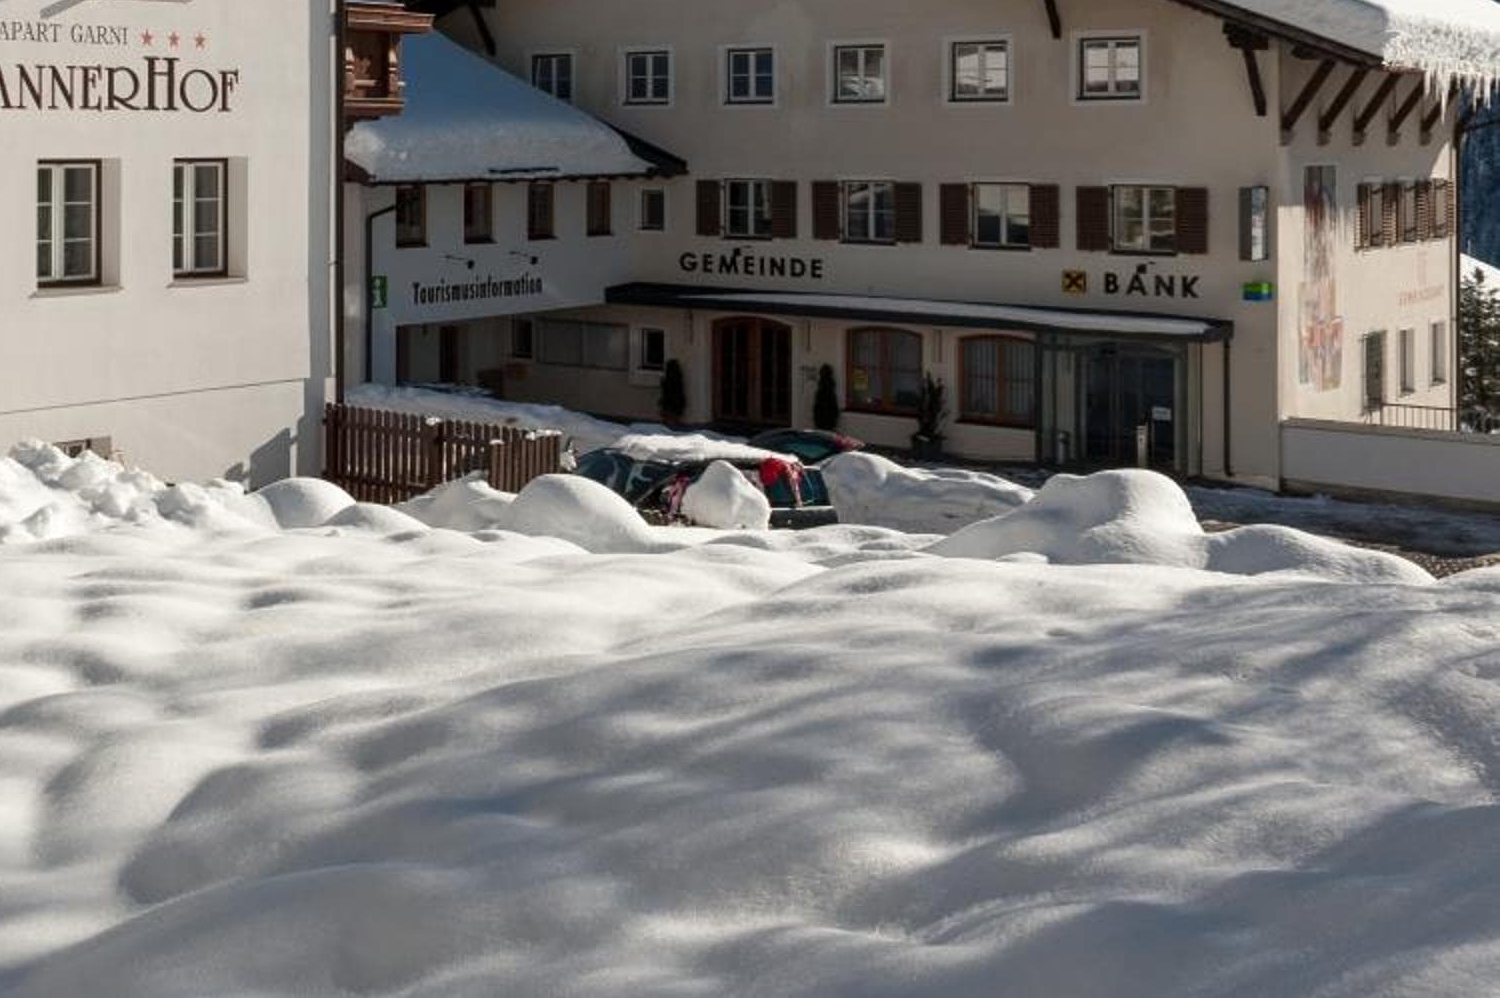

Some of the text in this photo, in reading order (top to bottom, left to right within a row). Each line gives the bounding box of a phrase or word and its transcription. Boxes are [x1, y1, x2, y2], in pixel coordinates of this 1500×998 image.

[70, 23, 129, 45] GARNI
[679, 252, 823, 278] GEMEINDE
[412, 272, 543, 304] Tourismusinformation
[1103, 273, 1199, 298] BANK
